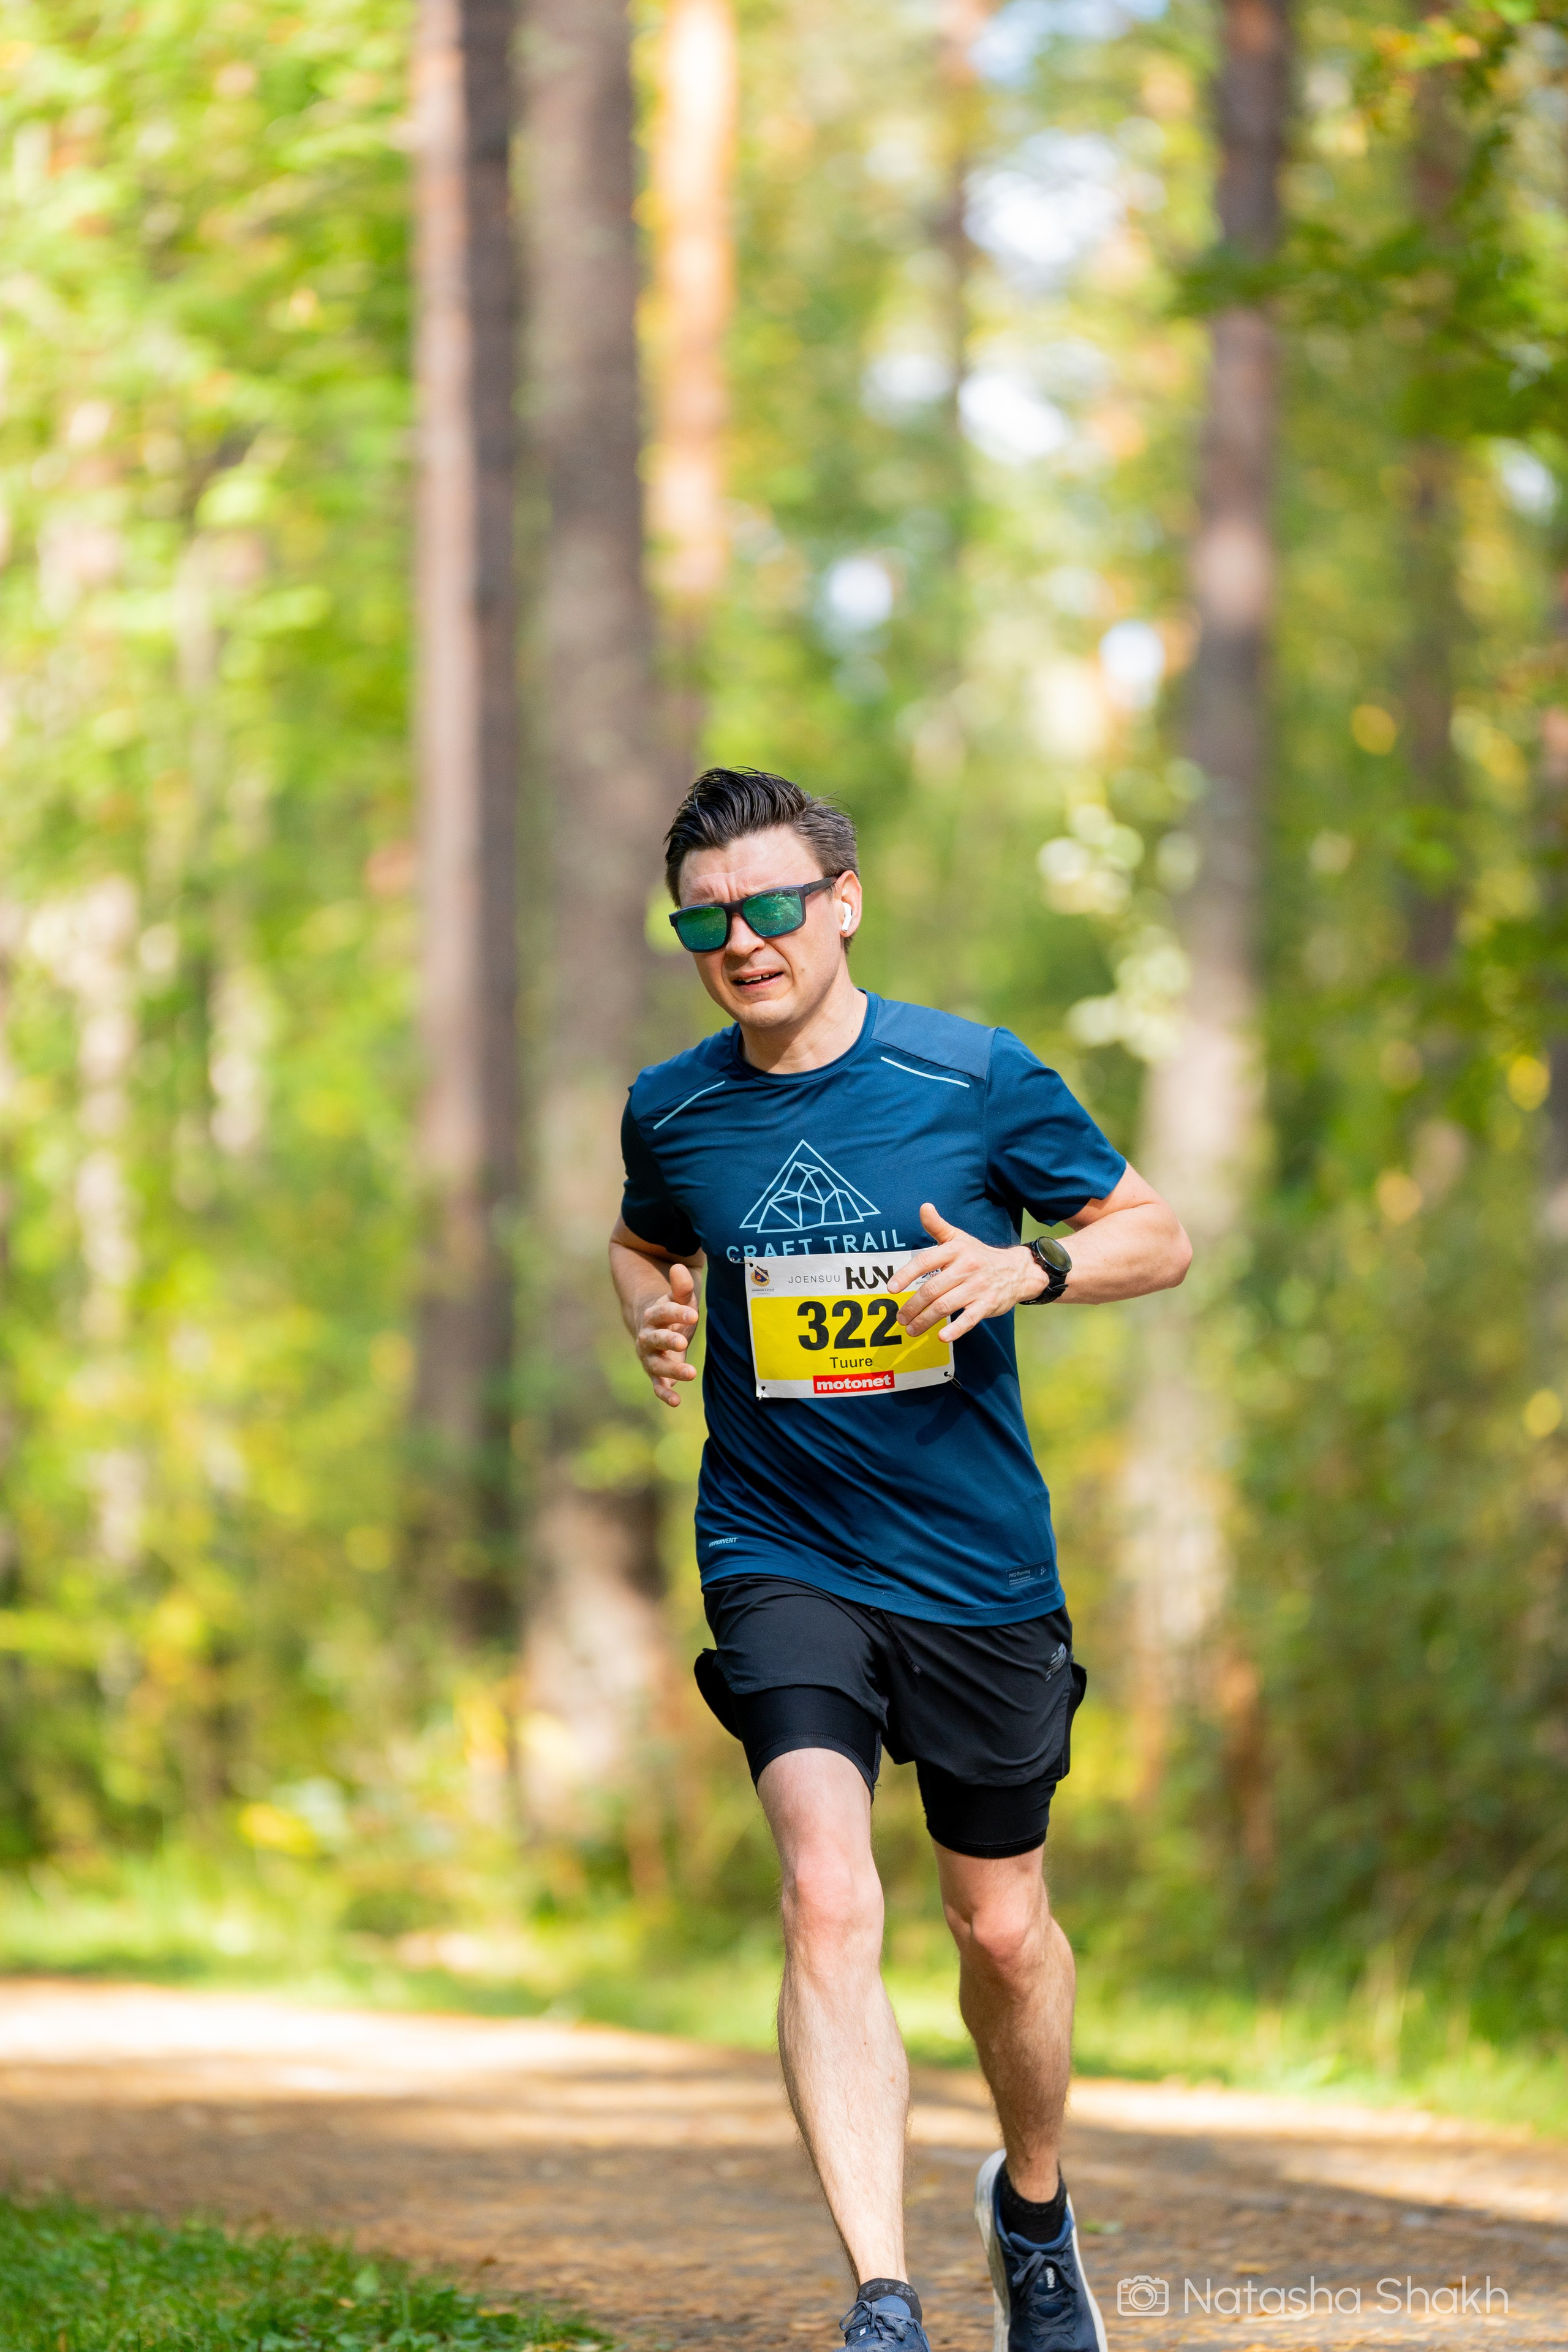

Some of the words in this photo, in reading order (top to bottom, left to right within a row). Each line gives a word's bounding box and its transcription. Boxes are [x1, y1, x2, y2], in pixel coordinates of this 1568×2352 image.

[726, 1238, 812, 1262] CRAFT
[824, 1229, 906, 1254] TRAIL
[788, 1275, 840, 1283] JOENSUU
[845, 1265, 894, 1289] RUN
[797, 1298, 902, 1351] 322
[830, 1357, 873, 1368] Tuure
[816, 1375, 891, 1390] motonet
